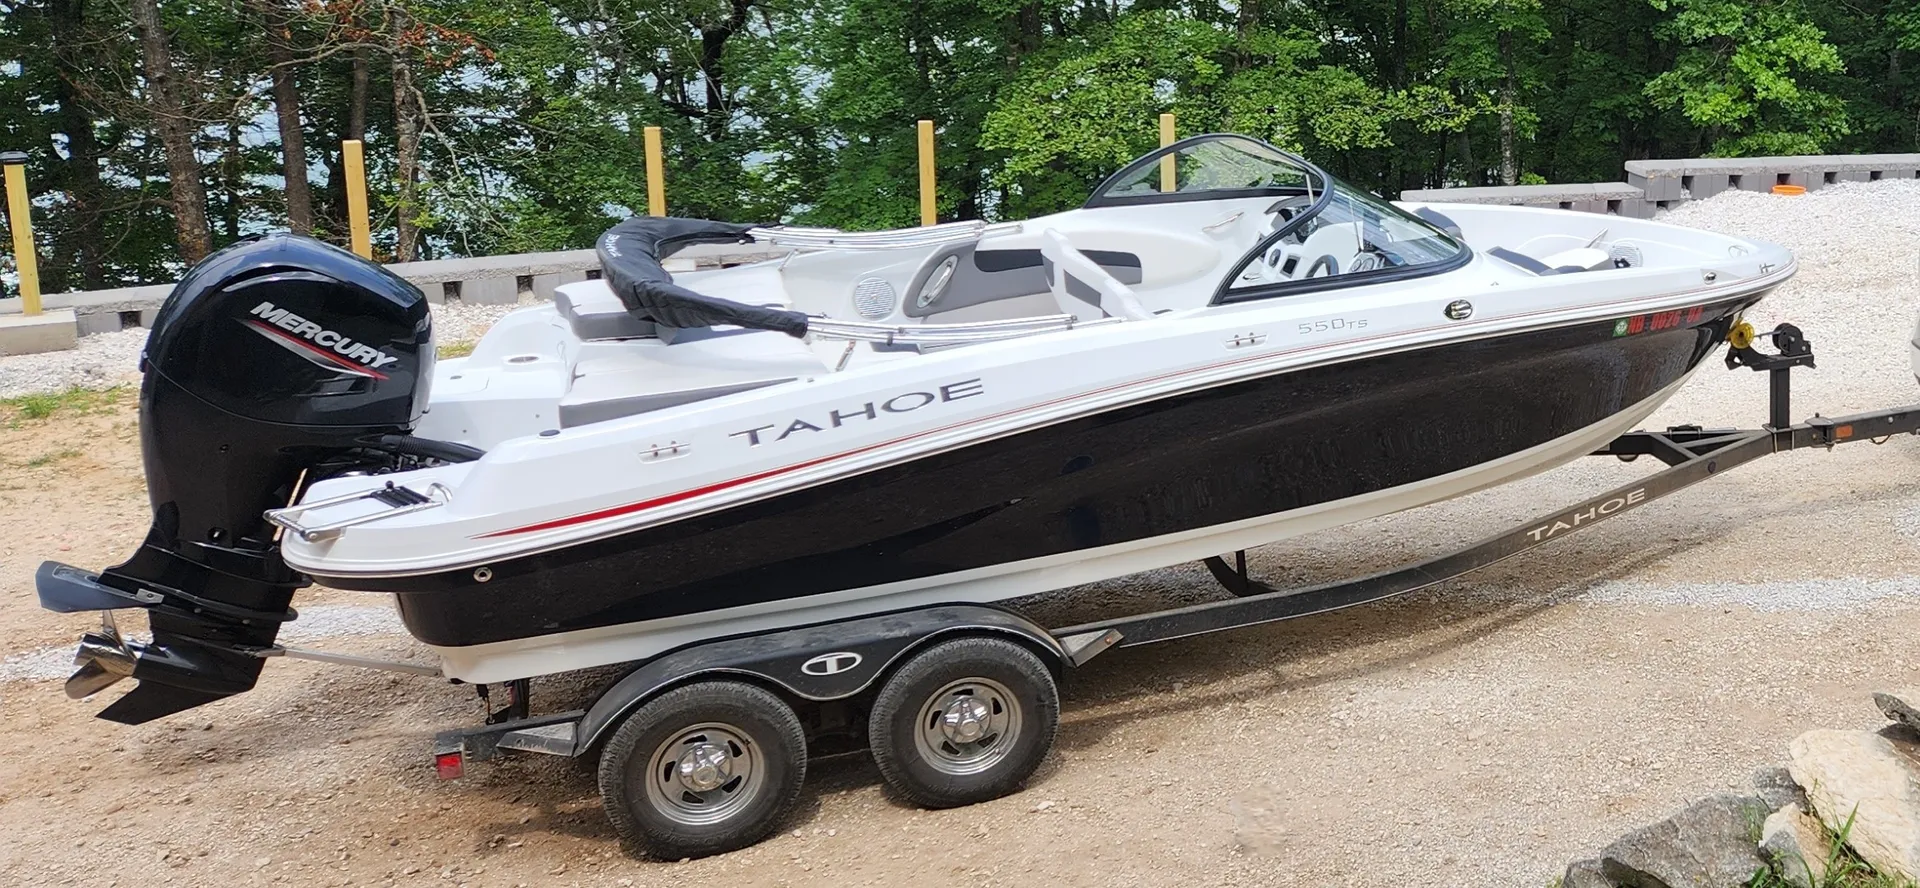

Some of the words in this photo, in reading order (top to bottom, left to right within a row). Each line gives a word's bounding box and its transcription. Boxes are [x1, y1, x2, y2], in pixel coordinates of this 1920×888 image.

[250, 301, 399, 368] MERCURY
[728, 377, 984, 447] TAHOE
[1526, 487, 1645, 541] TAHOE
